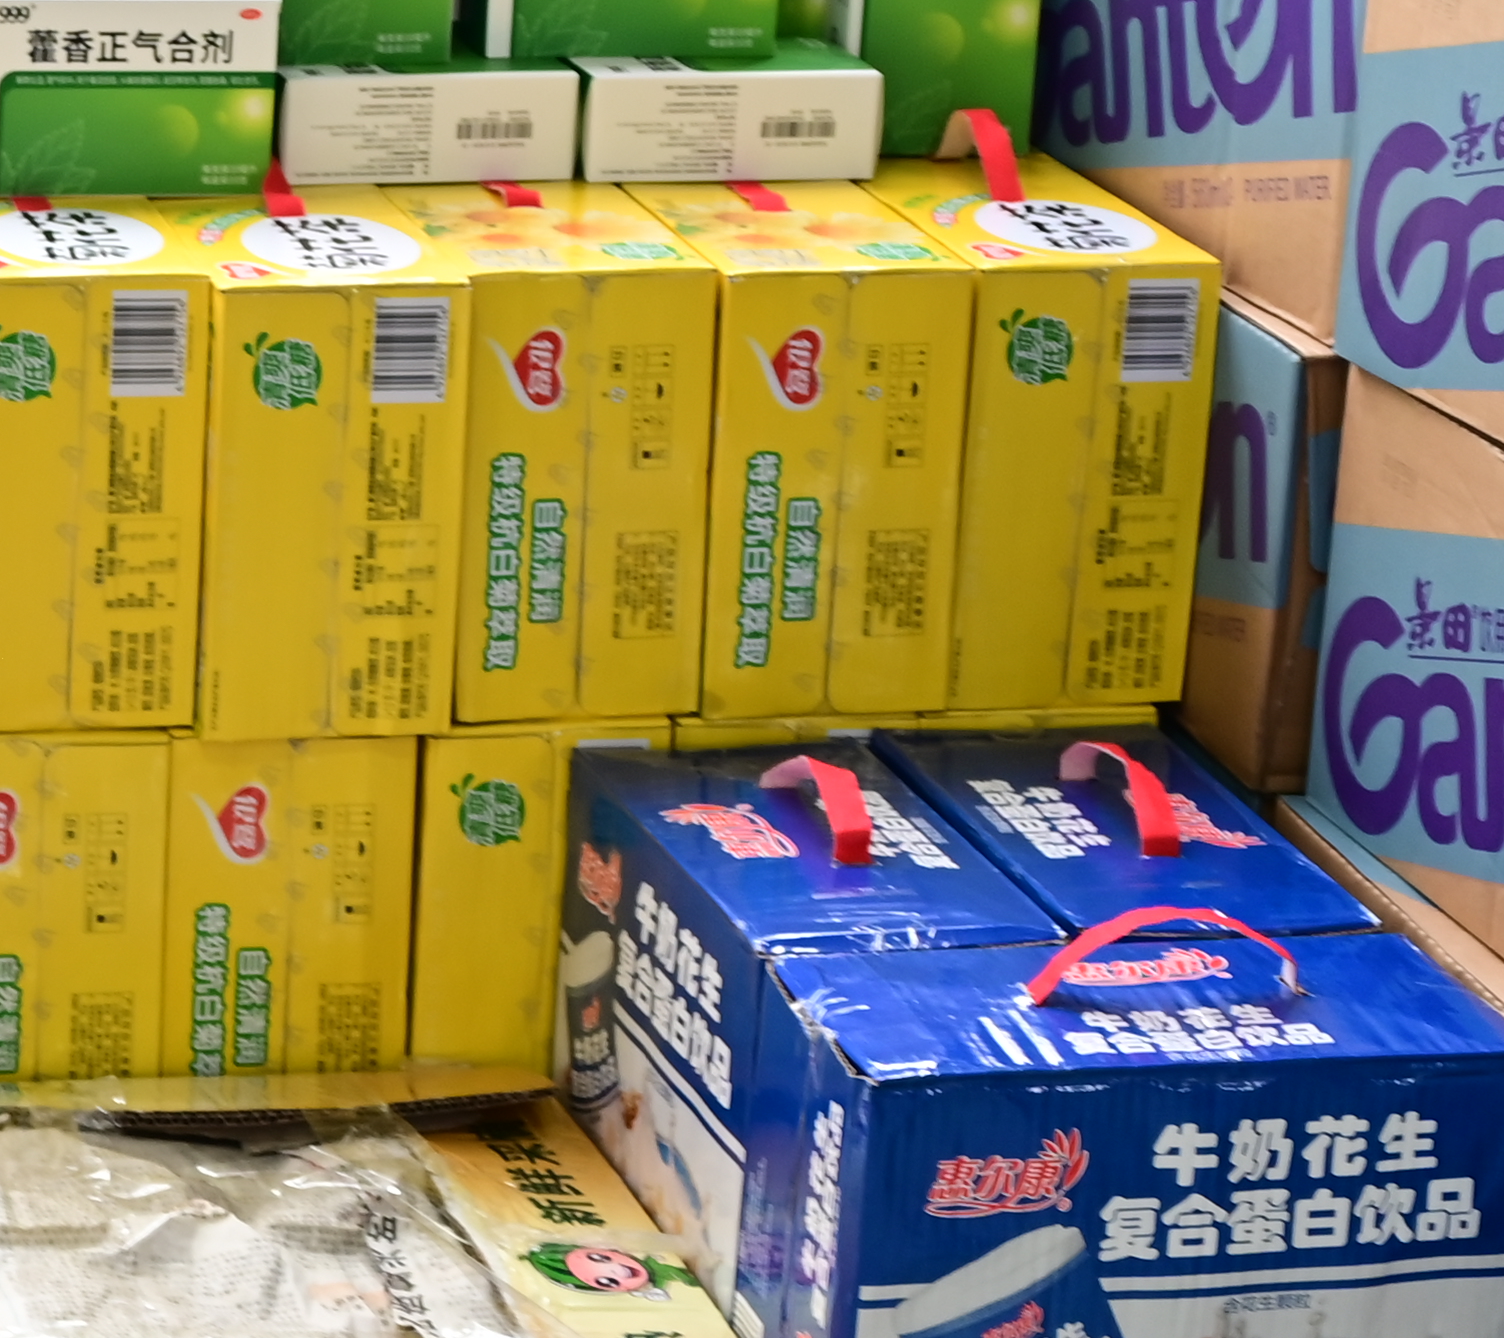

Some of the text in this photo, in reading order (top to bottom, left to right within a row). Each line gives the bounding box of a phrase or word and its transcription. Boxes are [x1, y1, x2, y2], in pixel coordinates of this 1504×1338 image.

[27, 29, 234, 65] 藿香正气合剂
[1402, 575, 1472, 653] 景田
[1064, 1023, 1335, 1055] 复合蛋白饮品
[1081, 1004, 1283, 1033] 牛奶花生
[1153, 1111, 1439, 1186] 牛奶花生
[1098, 1177, 1480, 1262] 复合蛋白饮品
